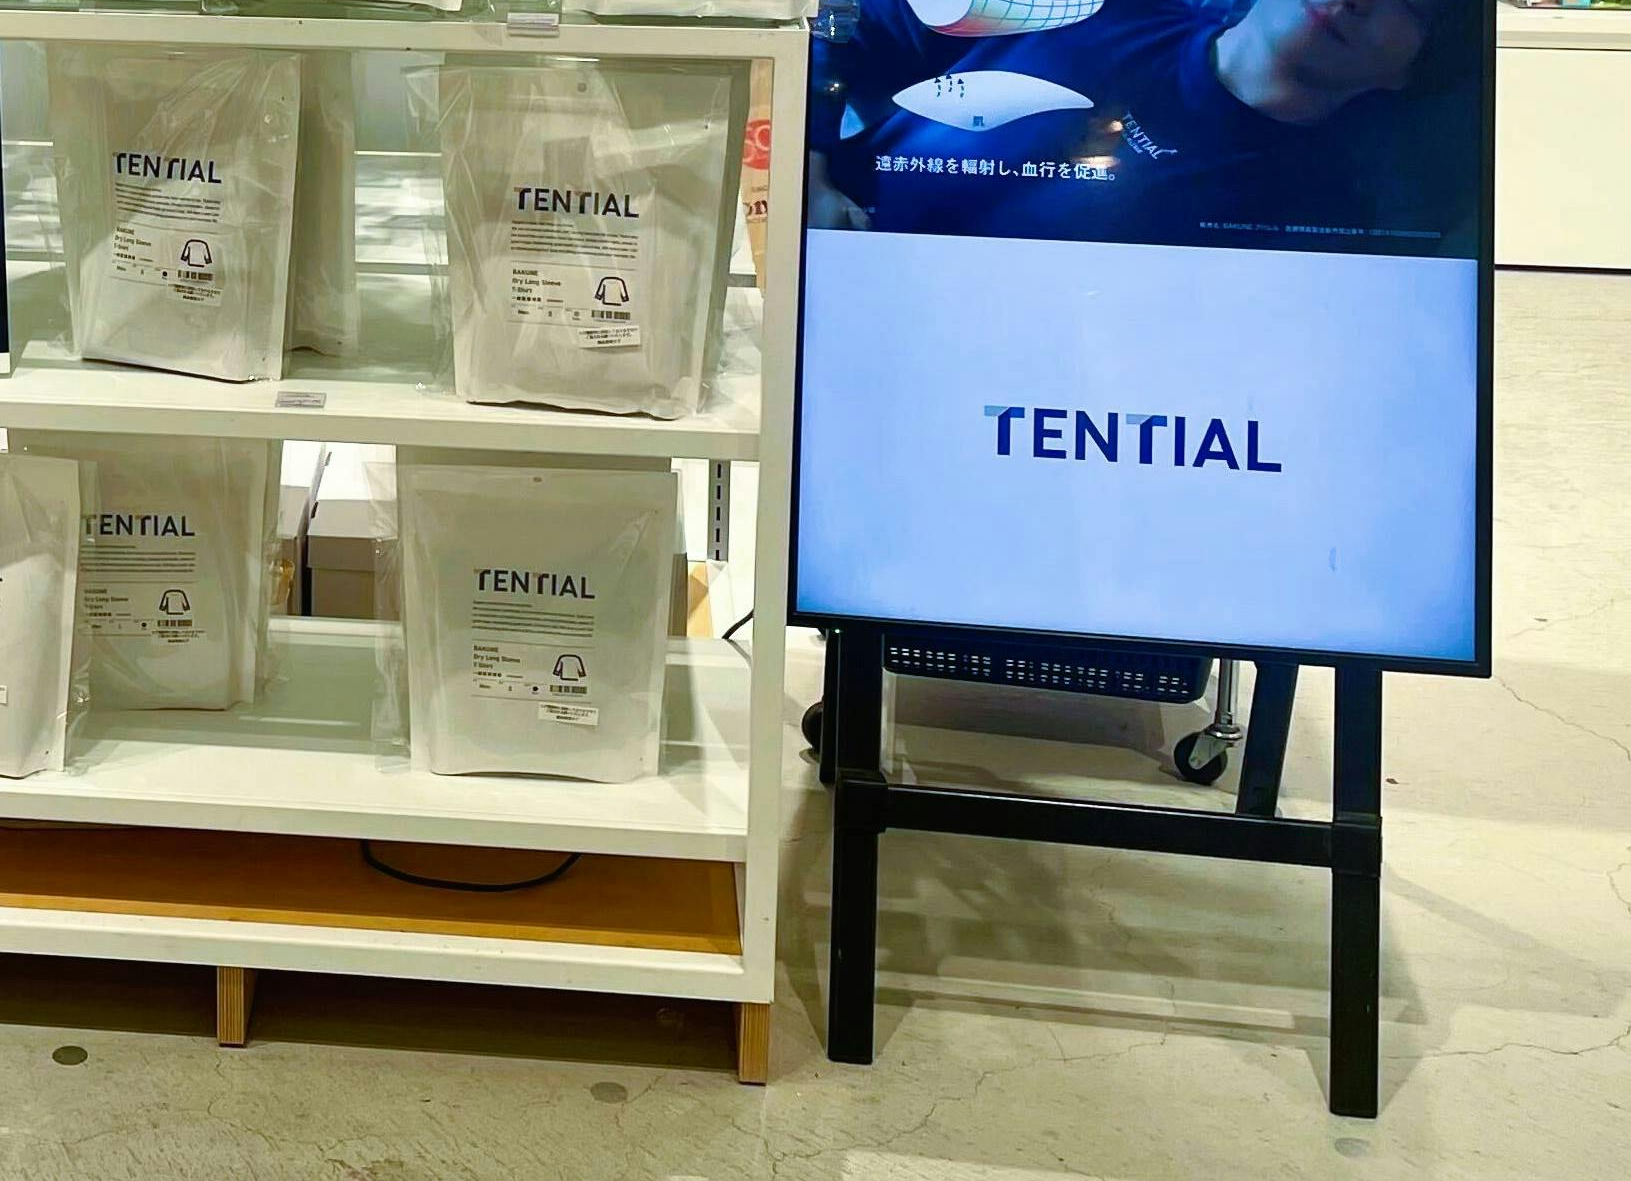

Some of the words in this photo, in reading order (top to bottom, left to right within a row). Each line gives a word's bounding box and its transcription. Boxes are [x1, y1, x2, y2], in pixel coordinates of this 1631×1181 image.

[112, 152, 222, 184] TENTIAL
[875, 155, 1116, 182] 遠赤外線を輻射し、血行を促進。
[514, 186, 640, 218] TENTIAL
[983, 405, 1283, 473] TENTIAL
[81, 513, 196, 538] TENTIAL
[473, 569, 596, 600] TENTIAL
